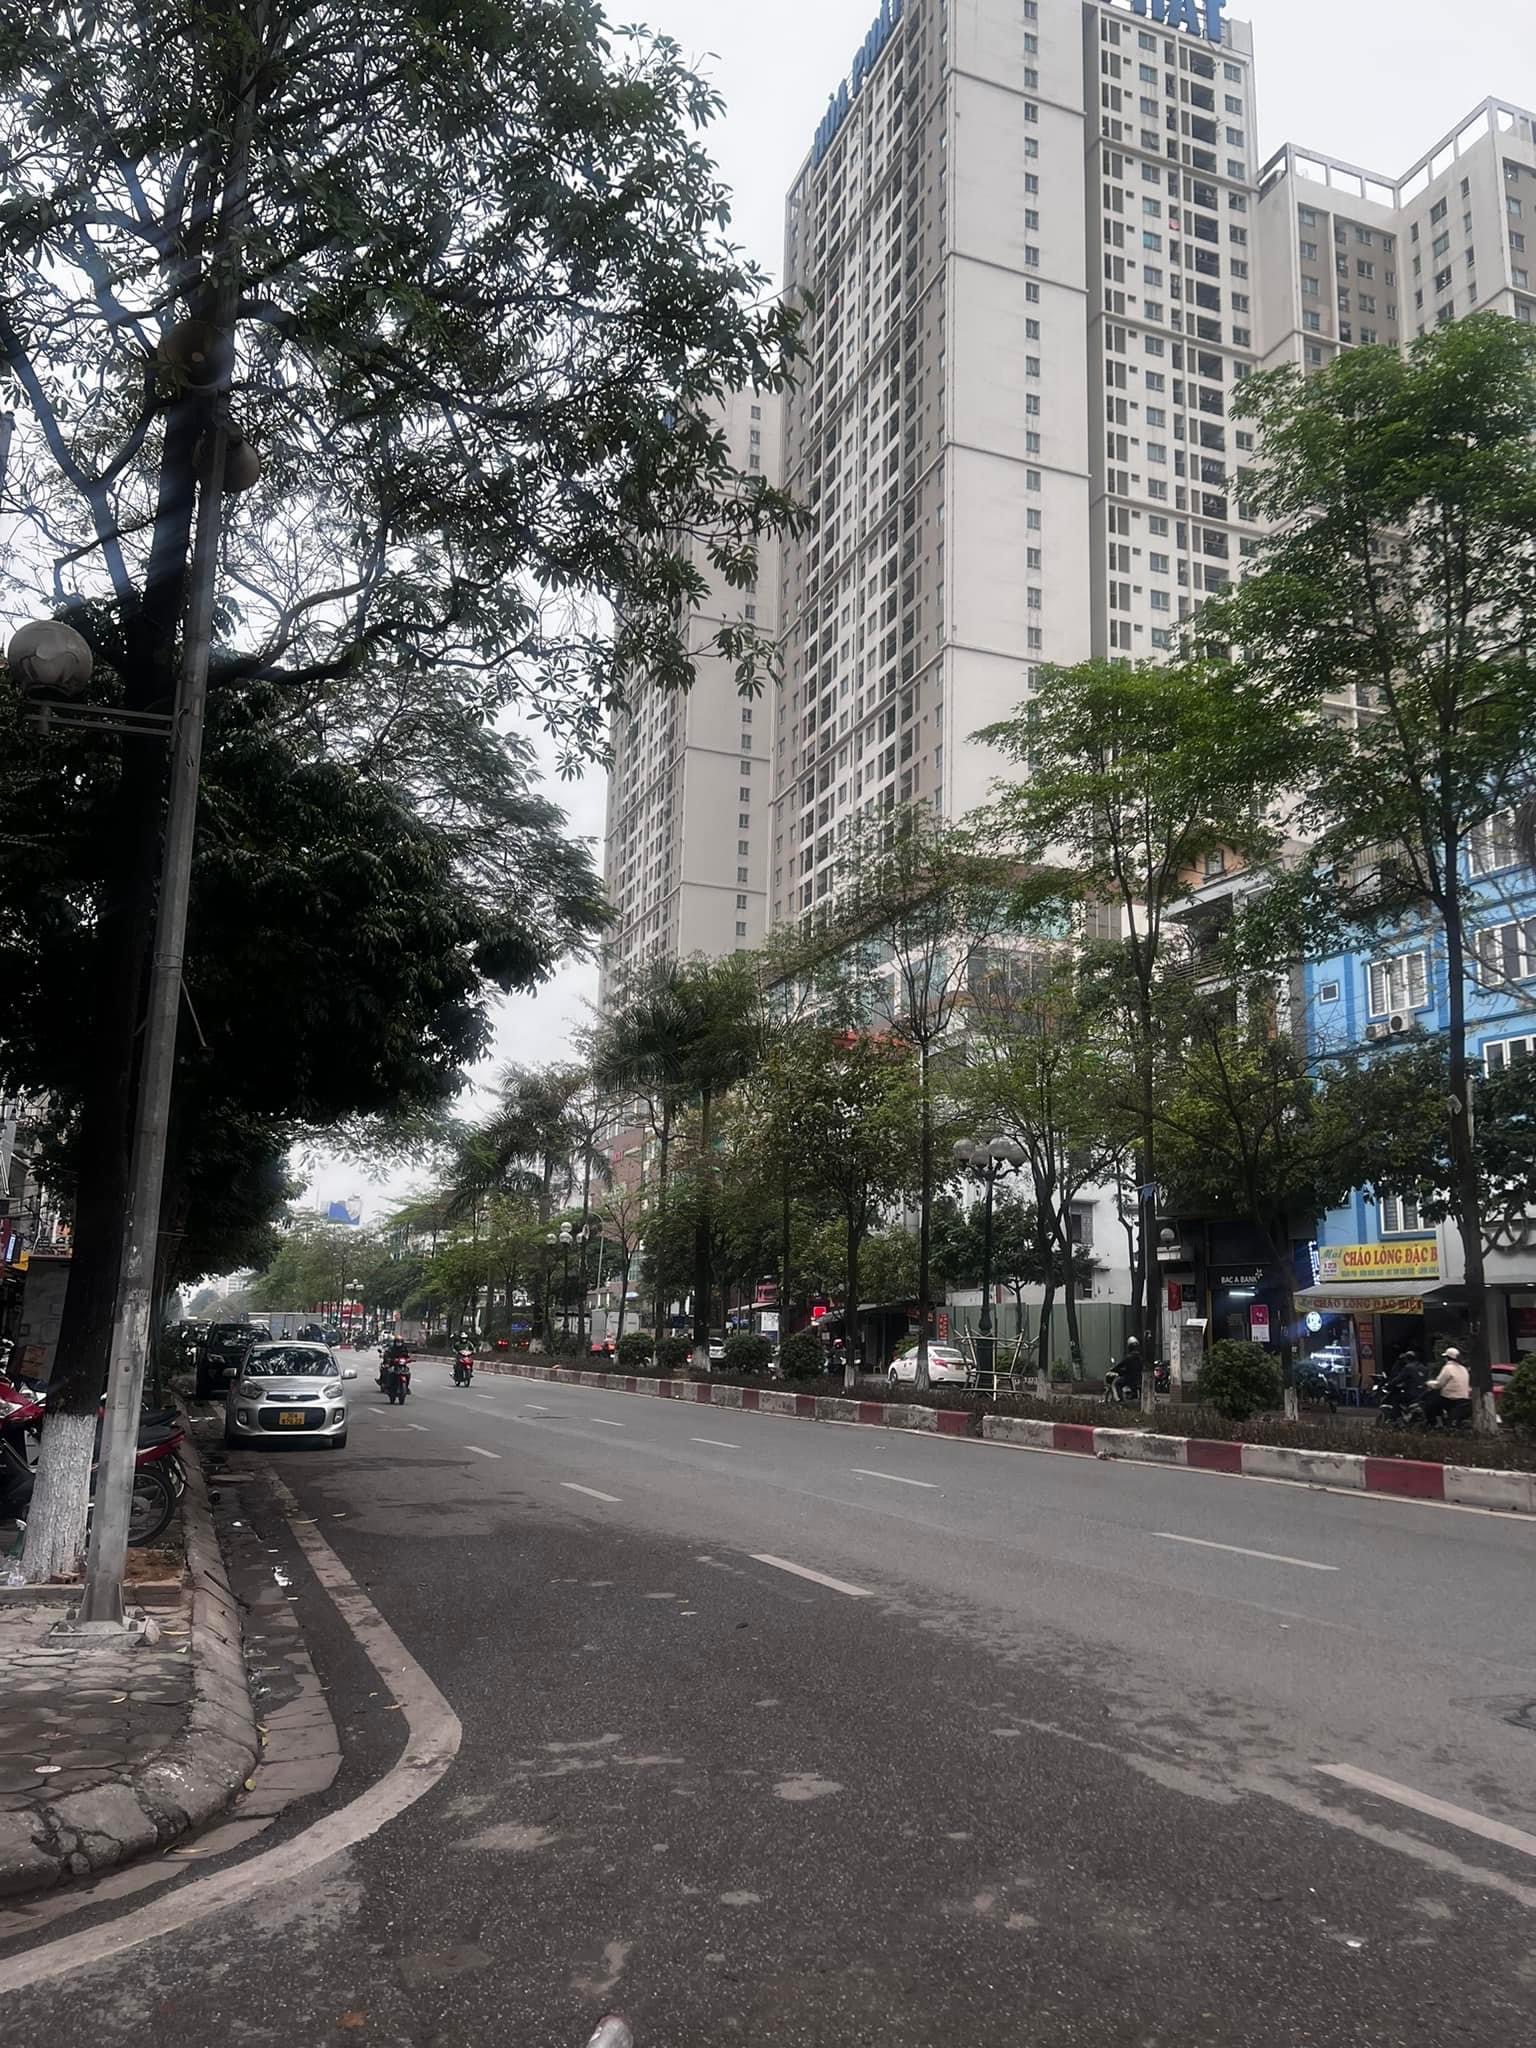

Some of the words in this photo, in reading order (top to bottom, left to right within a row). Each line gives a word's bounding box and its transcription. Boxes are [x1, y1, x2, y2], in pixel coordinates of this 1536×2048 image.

[1343, 1246, 1371, 1268] CHÁO
[1374, 1246, 1402, 1266] LÒNG
[1405, 1243, 1428, 1267] ĐẶC
